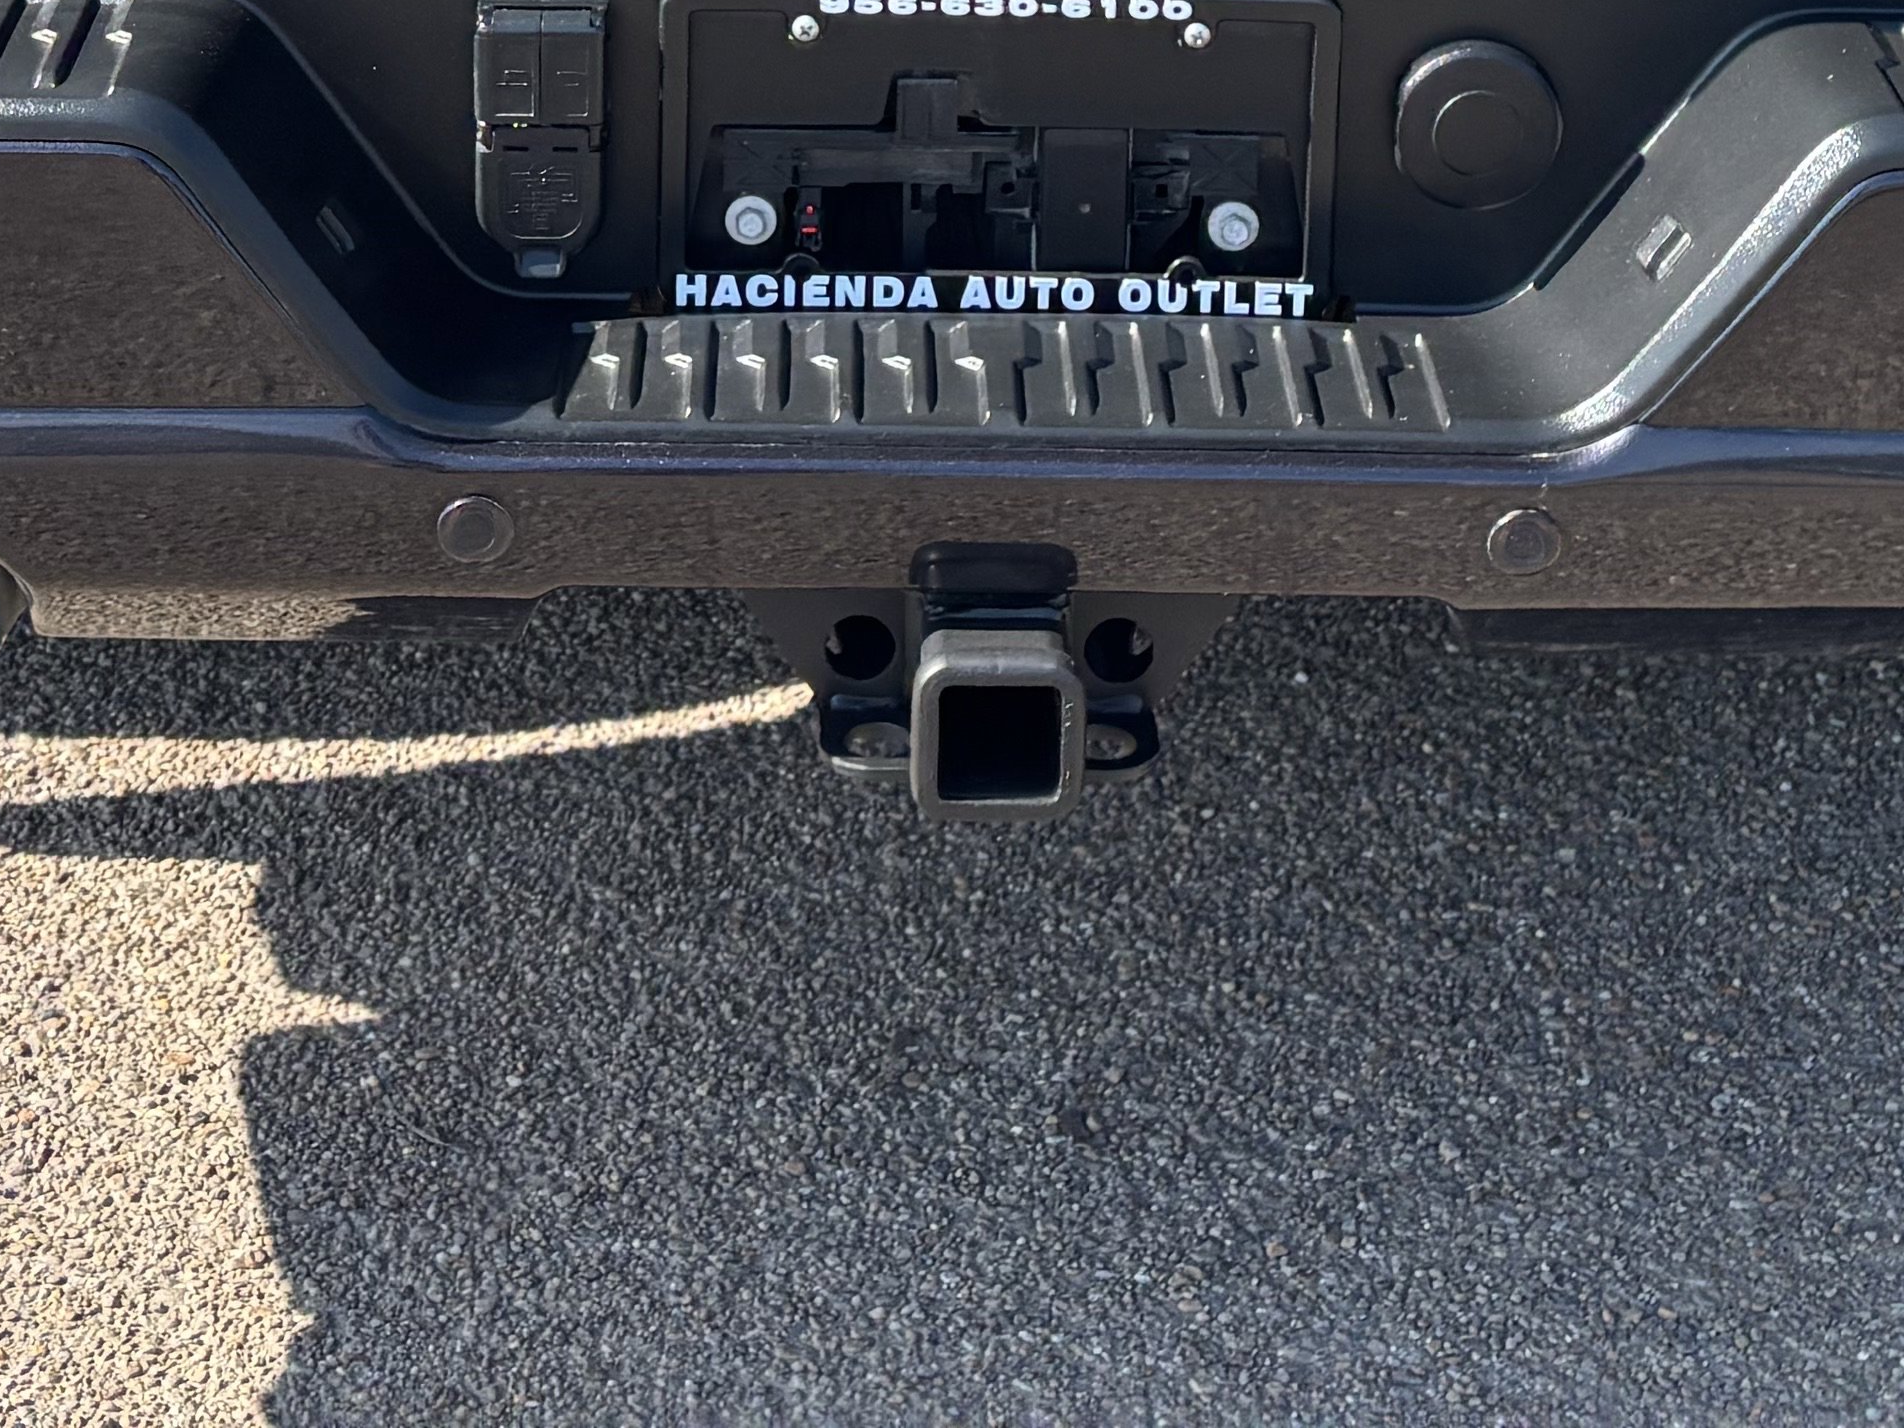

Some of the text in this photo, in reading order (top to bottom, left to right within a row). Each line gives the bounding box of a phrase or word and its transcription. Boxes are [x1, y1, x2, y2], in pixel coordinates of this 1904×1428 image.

[674, 273, 1315, 318] HACIENDA AUTO OUTLET
